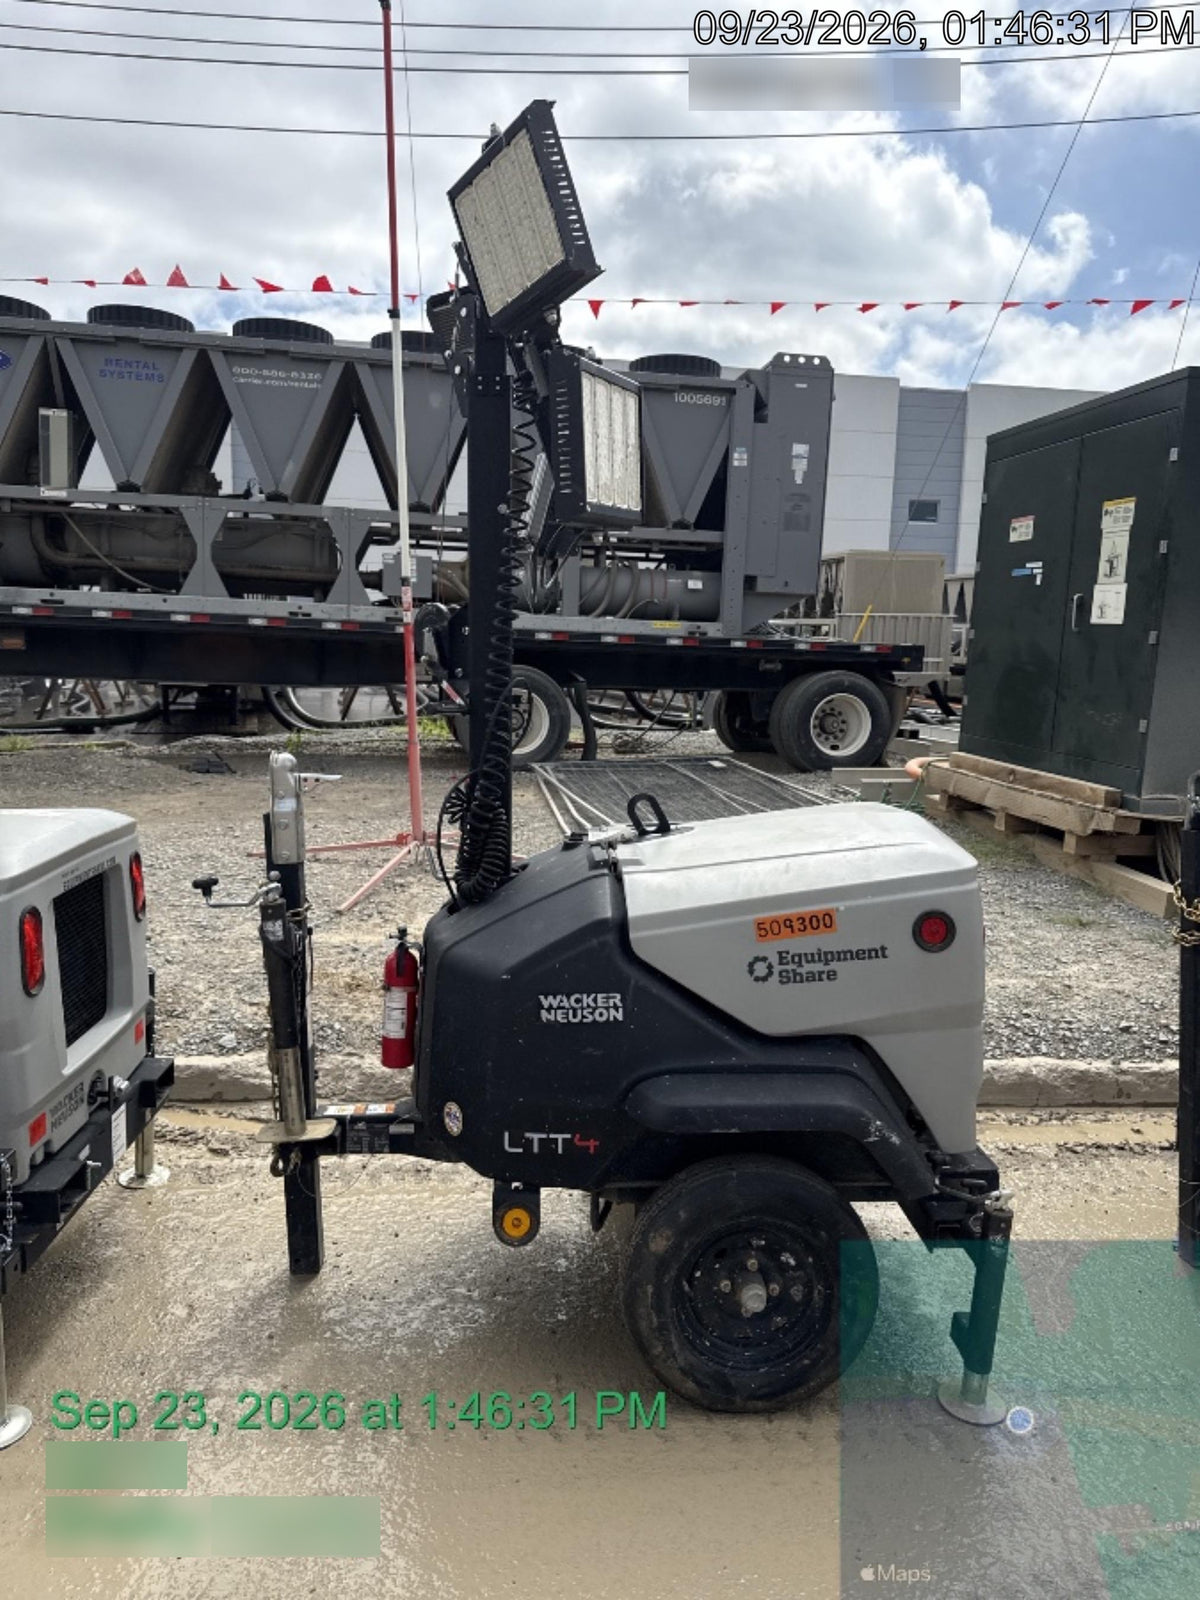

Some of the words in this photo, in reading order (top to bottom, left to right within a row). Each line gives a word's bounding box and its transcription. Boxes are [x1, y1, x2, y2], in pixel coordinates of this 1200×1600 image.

[104, 358, 160, 371] RENTAL
[99, 368, 165, 383] SYSTEMS
[756, 912, 834, 938] 509300
[777, 944, 889, 968] Equipment
[778, 968, 838, 985] Share
[538, 993, 623, 1009] WACKER
[540, 1007, 624, 1023] NEUSON
